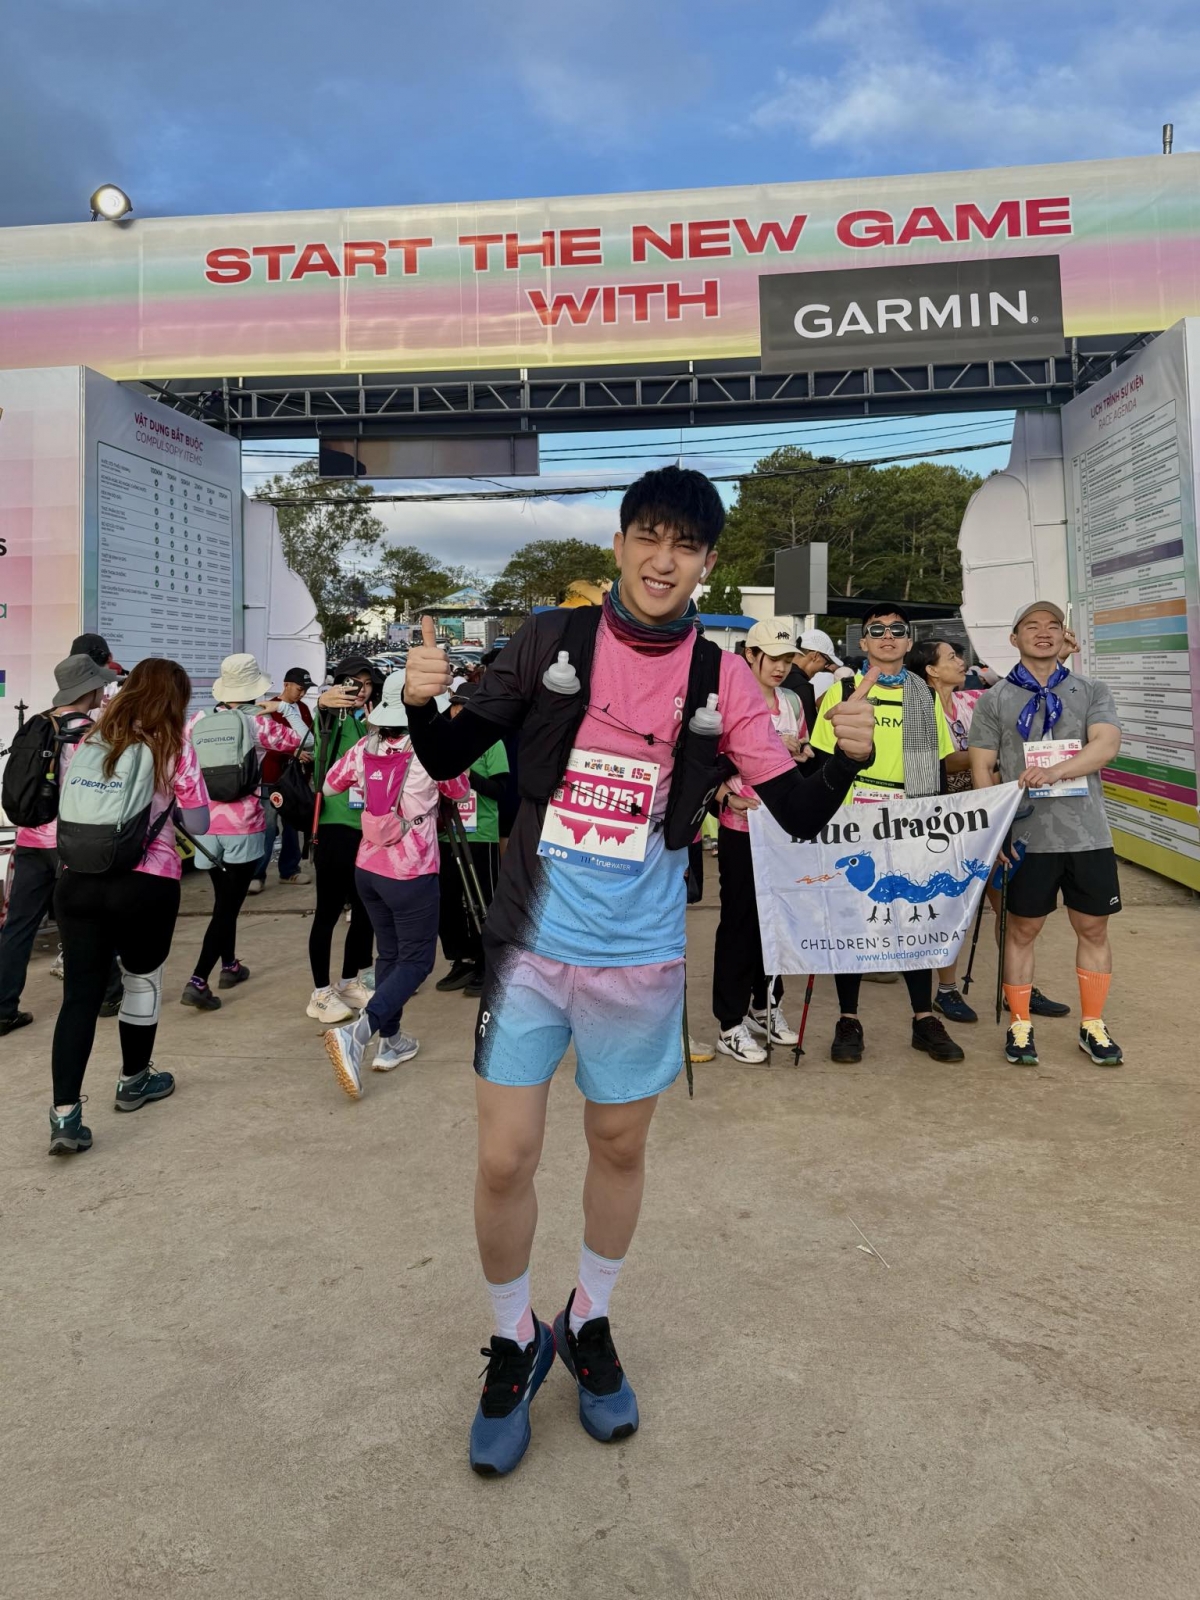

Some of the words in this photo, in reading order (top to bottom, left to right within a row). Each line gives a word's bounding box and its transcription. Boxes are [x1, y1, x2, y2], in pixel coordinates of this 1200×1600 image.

[205, 237, 434, 284] START
[458, 227, 603, 271] THE
[631, 214, 808, 263] NEW
[836, 197, 1073, 248] GAME
[525, 278, 720, 327] WITH
[150, 419, 170, 437] DỤNG
[874, 717, 903, 727] ARM
[790, 821, 862, 845] ue
[872, 806, 990, 853] dragon
[800, 937, 891, 950] CHILDREN'S
[898, 929, 968, 947] FOUNDAT
[856, 947, 949, 962] www.bluedragon.org
